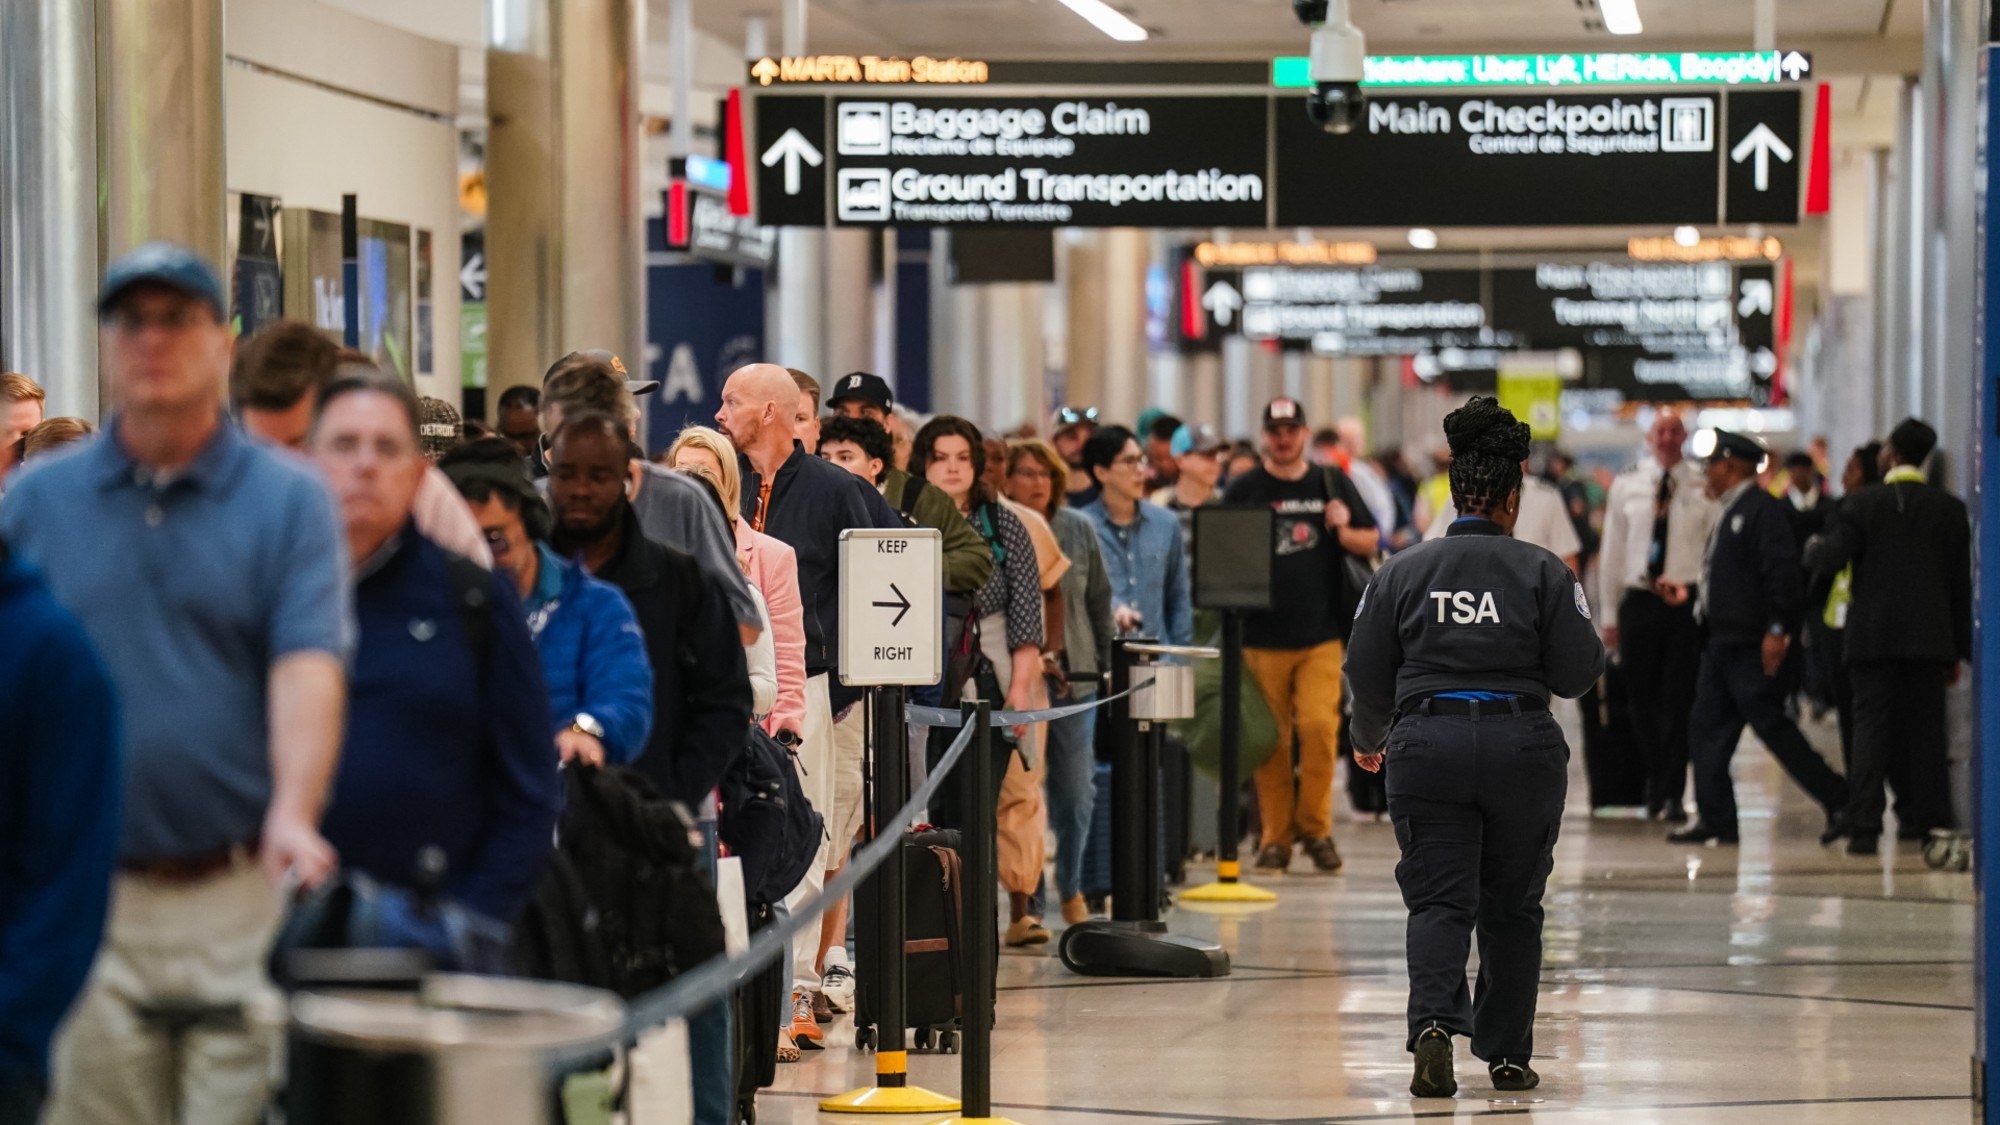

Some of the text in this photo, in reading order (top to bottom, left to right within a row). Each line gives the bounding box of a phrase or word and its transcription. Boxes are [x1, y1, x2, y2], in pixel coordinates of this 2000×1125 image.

[780, 55, 988, 83] MARTA Train Station
[1363, 55, 1470, 82] ideshare:
[1473, 54, 1535, 84] Uber,
[891, 101, 1150, 140] Baggage Claim
[1369, 99, 1659, 137] Main Checkpoint
[969, 135, 996, 155] de
[1469, 133, 1659, 156] Control de Seguridad
[892, 167, 1262, 206] Ground Transportation
[877, 540, 908, 553] KEEP
[1430, 591, 1500, 624] TSA
[874, 647, 913, 660] RIGHT
